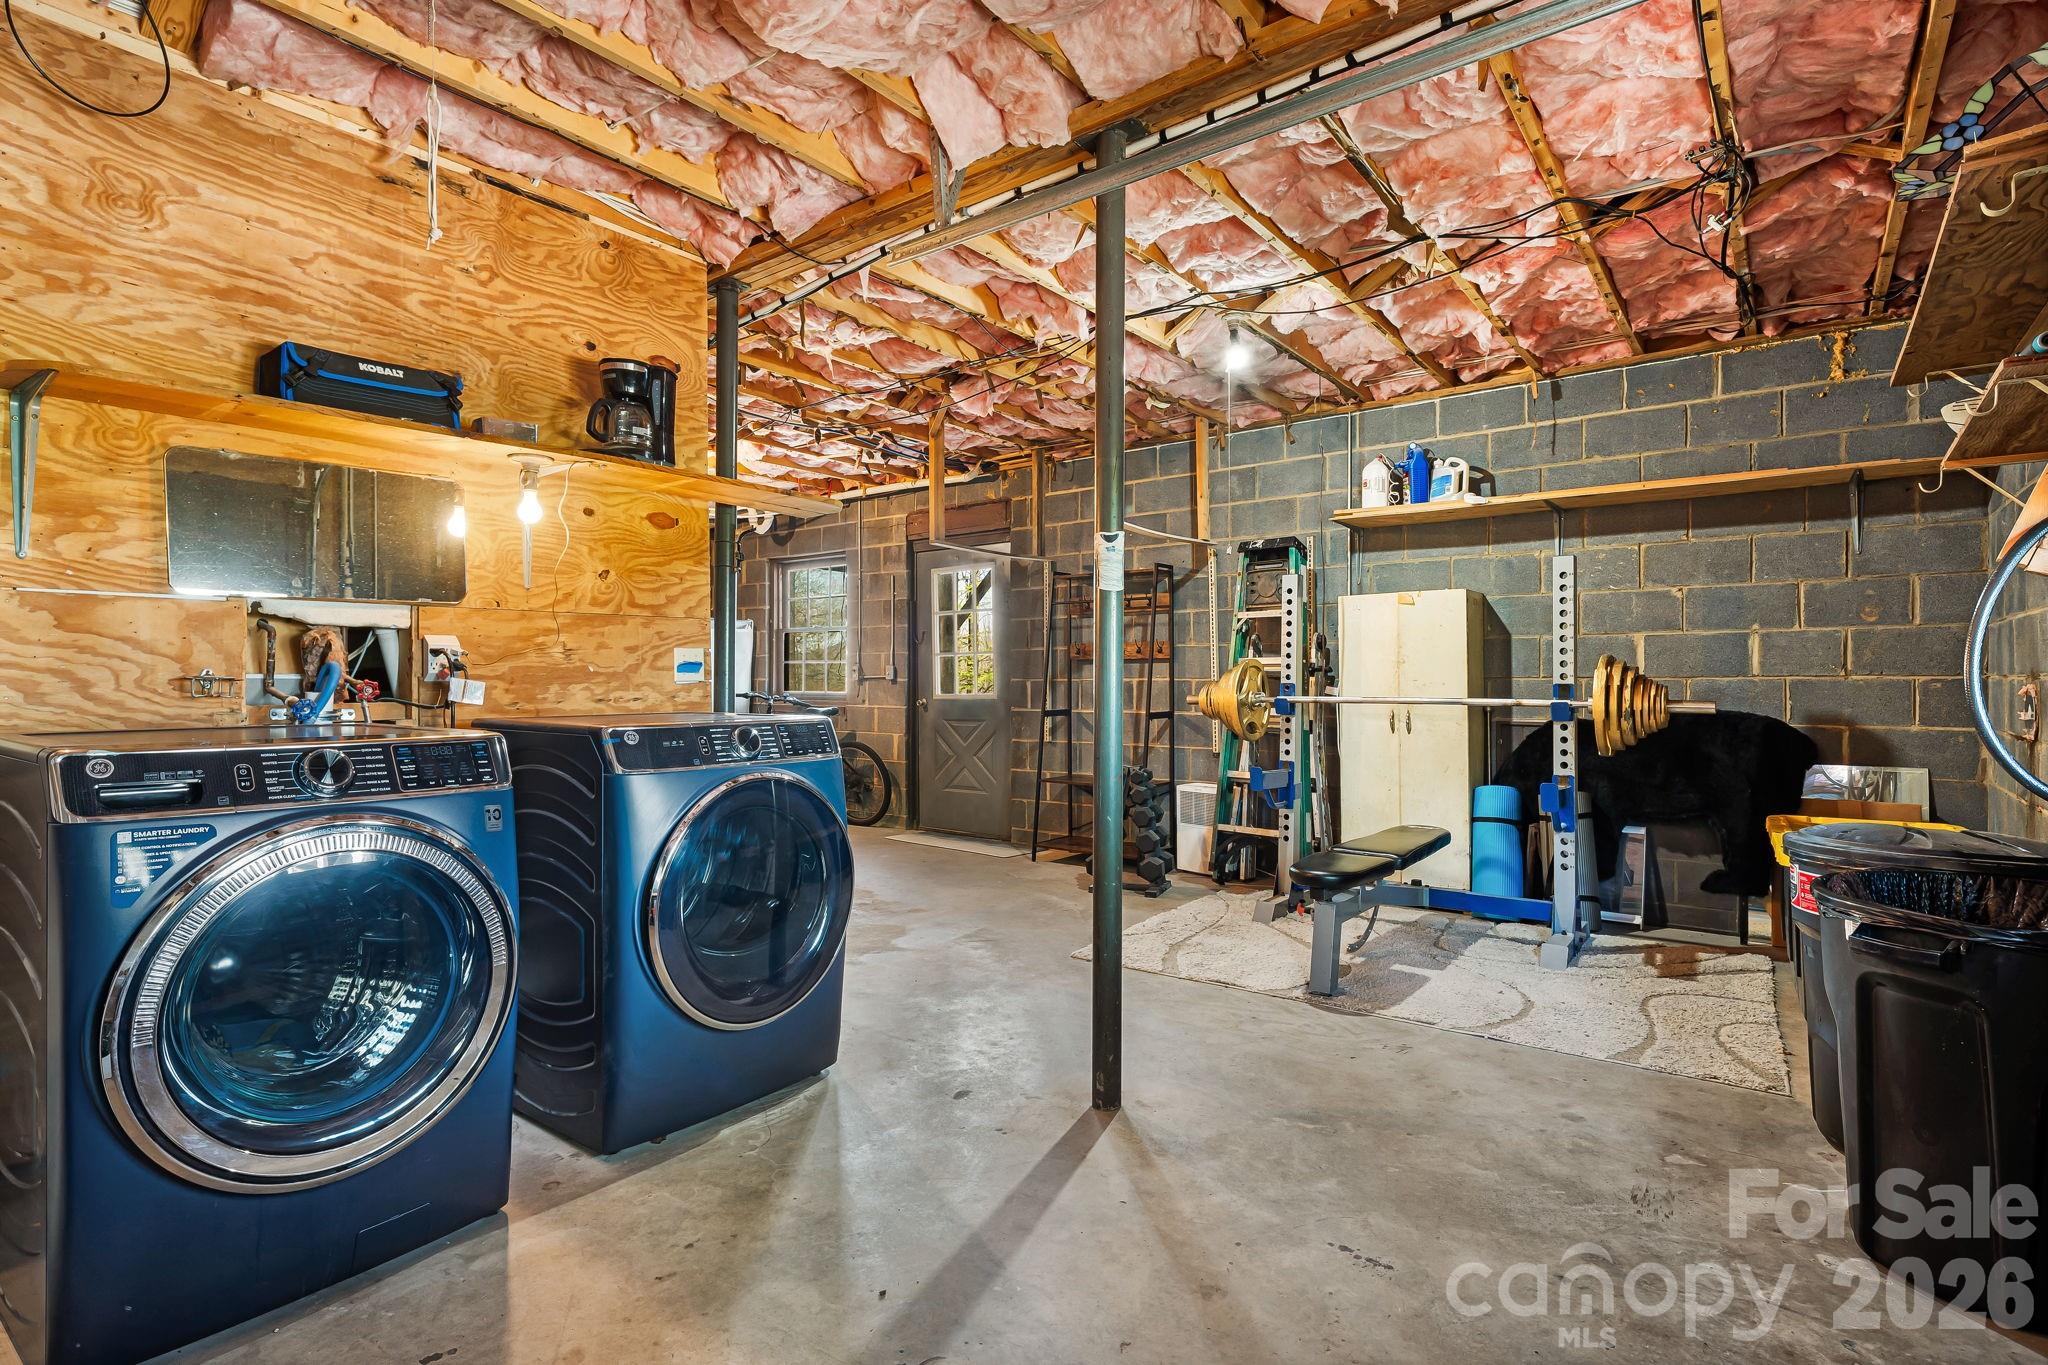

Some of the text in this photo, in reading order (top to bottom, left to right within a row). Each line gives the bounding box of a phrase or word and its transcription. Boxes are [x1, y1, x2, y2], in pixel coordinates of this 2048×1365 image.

[358, 362, 404, 379] KOBALT
[133, 827, 210, 838] SMARTER LAUNDRY
